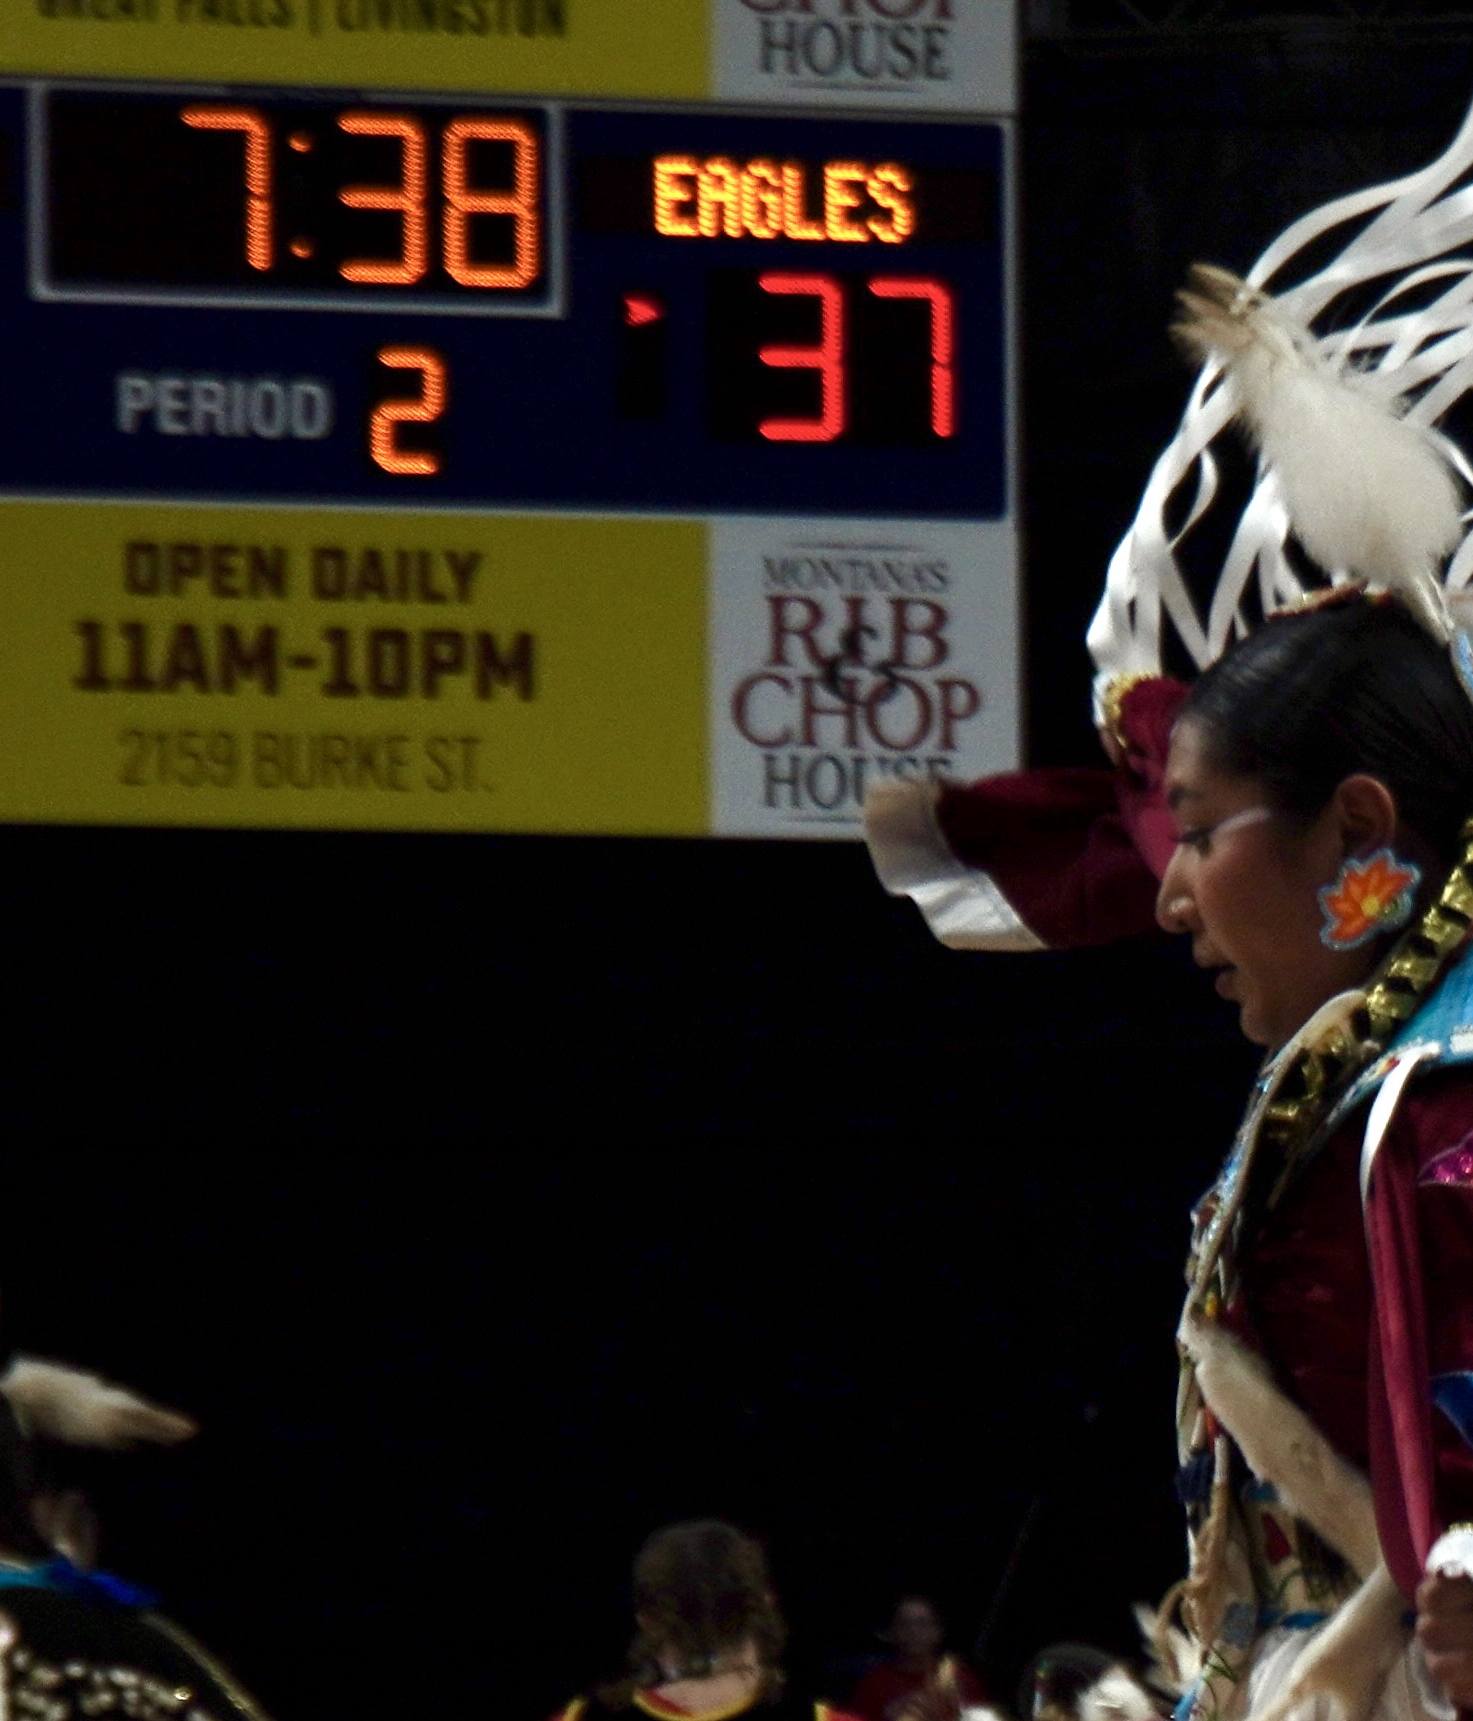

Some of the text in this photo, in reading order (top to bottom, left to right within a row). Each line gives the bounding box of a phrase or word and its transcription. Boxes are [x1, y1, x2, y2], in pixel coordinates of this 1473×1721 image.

[760, 16, 953, 83] HOUSE
[181, 110, 538, 289] 7:38
[652, 155, 915, 244] EAGLES
[758, 273, 955, 442] 37
[115, 370, 335, 440] PERIOD
[369, 344, 446, 476] 2
[123, 541, 485, 604] OPEN DAILY
[72, 619, 537, 701] 11AM-10PM
[731, 672, 983, 752] CHOP
[120, 729, 494, 794] 2159 BURKE ST.
